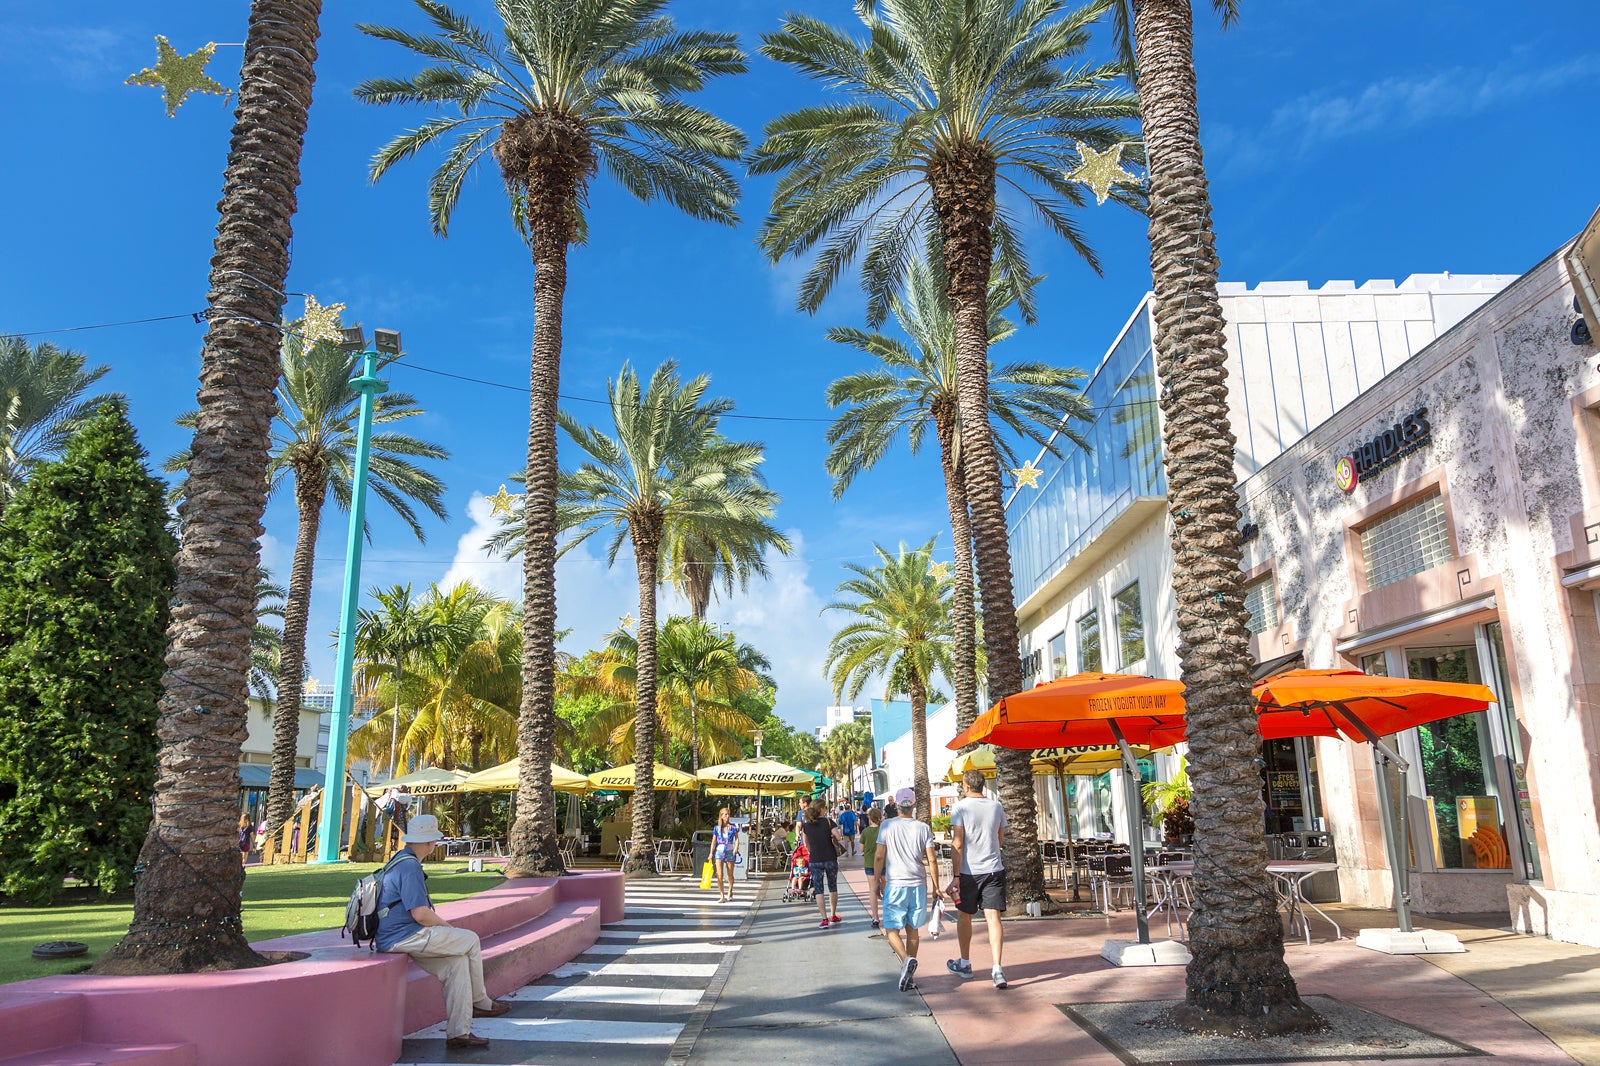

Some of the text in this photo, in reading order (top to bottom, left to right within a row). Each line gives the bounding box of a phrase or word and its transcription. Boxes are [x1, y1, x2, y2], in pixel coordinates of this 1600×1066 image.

[1337, 463, 1350, 487] 16
[1352, 407, 1431, 474] HANDLES
[1088, 694, 1167, 712] FROZEN YOGURT YOUR WAY
[600, 777, 679, 787] PIZZA TICA
[717, 772, 794, 783] PIZZA RUSTICA
[414, 784, 458, 794] RUSTICA
